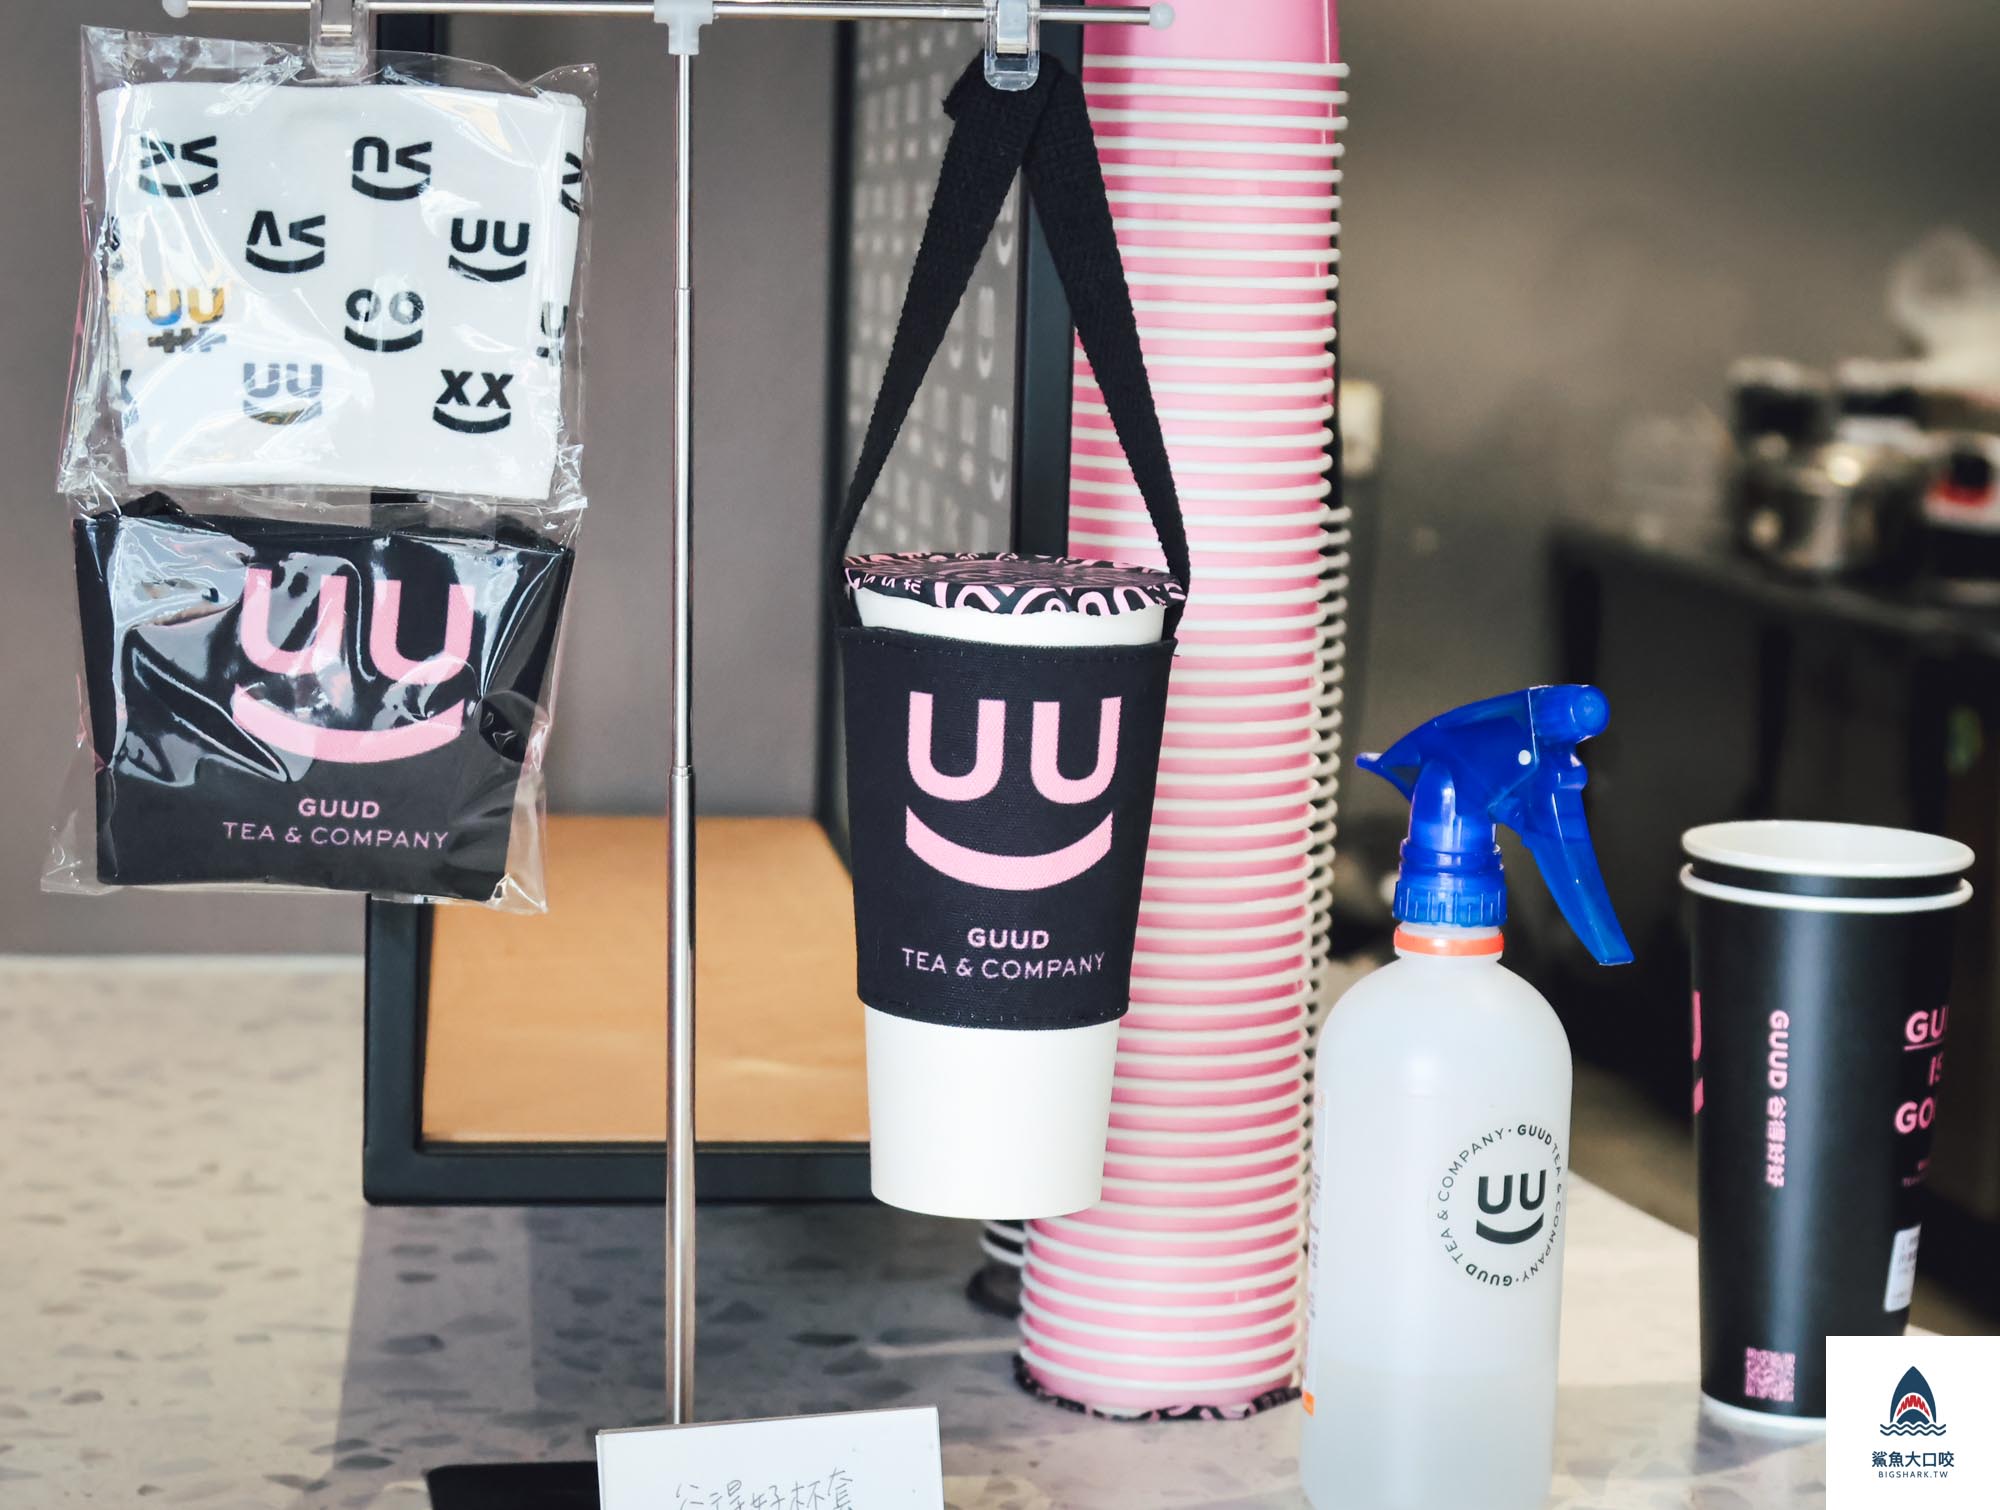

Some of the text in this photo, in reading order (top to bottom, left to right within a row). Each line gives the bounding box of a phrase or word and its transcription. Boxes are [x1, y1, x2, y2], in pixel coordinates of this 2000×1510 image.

[297, 797, 381, 820] GUUD
[222, 821, 449, 850] TEA & COMPANY
[967, 927, 1050, 950] GUUD
[902, 948, 1105, 980] TEA & COMPANY
[1905, 1004, 1949, 1043] GU
[1767, 1009, 1790, 1090] GUUD
[1894, 1097, 1937, 1133] GO
[1517, 1124, 1552, 1145] GUUD
[1551, 1143, 1563, 1176] TEA
[1437, 1127, 1513, 1287] GUUD TEA & COMPANY
[1522, 1201, 1562, 1283] COMPANY
